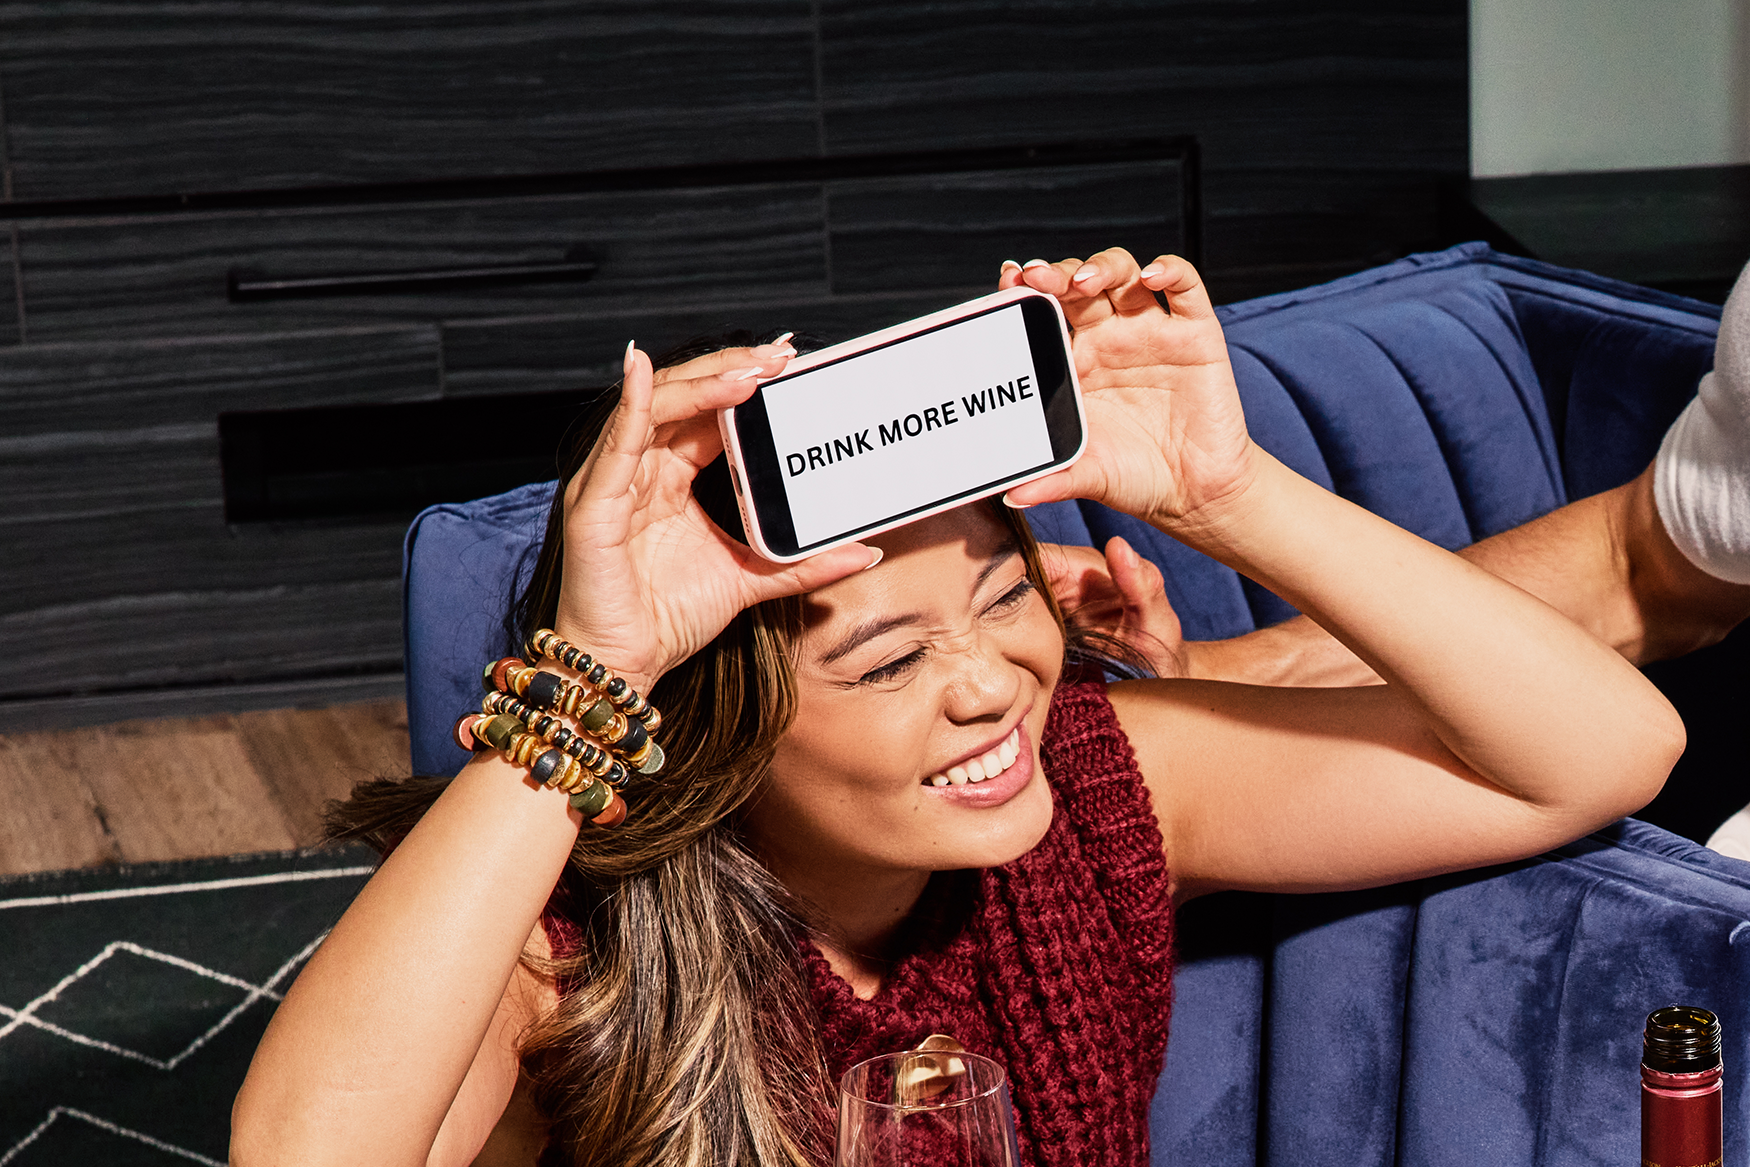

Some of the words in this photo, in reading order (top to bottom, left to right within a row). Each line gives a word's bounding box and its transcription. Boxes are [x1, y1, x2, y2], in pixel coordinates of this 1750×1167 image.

[786, 429, 874, 477] DRINK
[878, 401, 958, 446] MORE
[961, 375, 1034, 418] WINE
